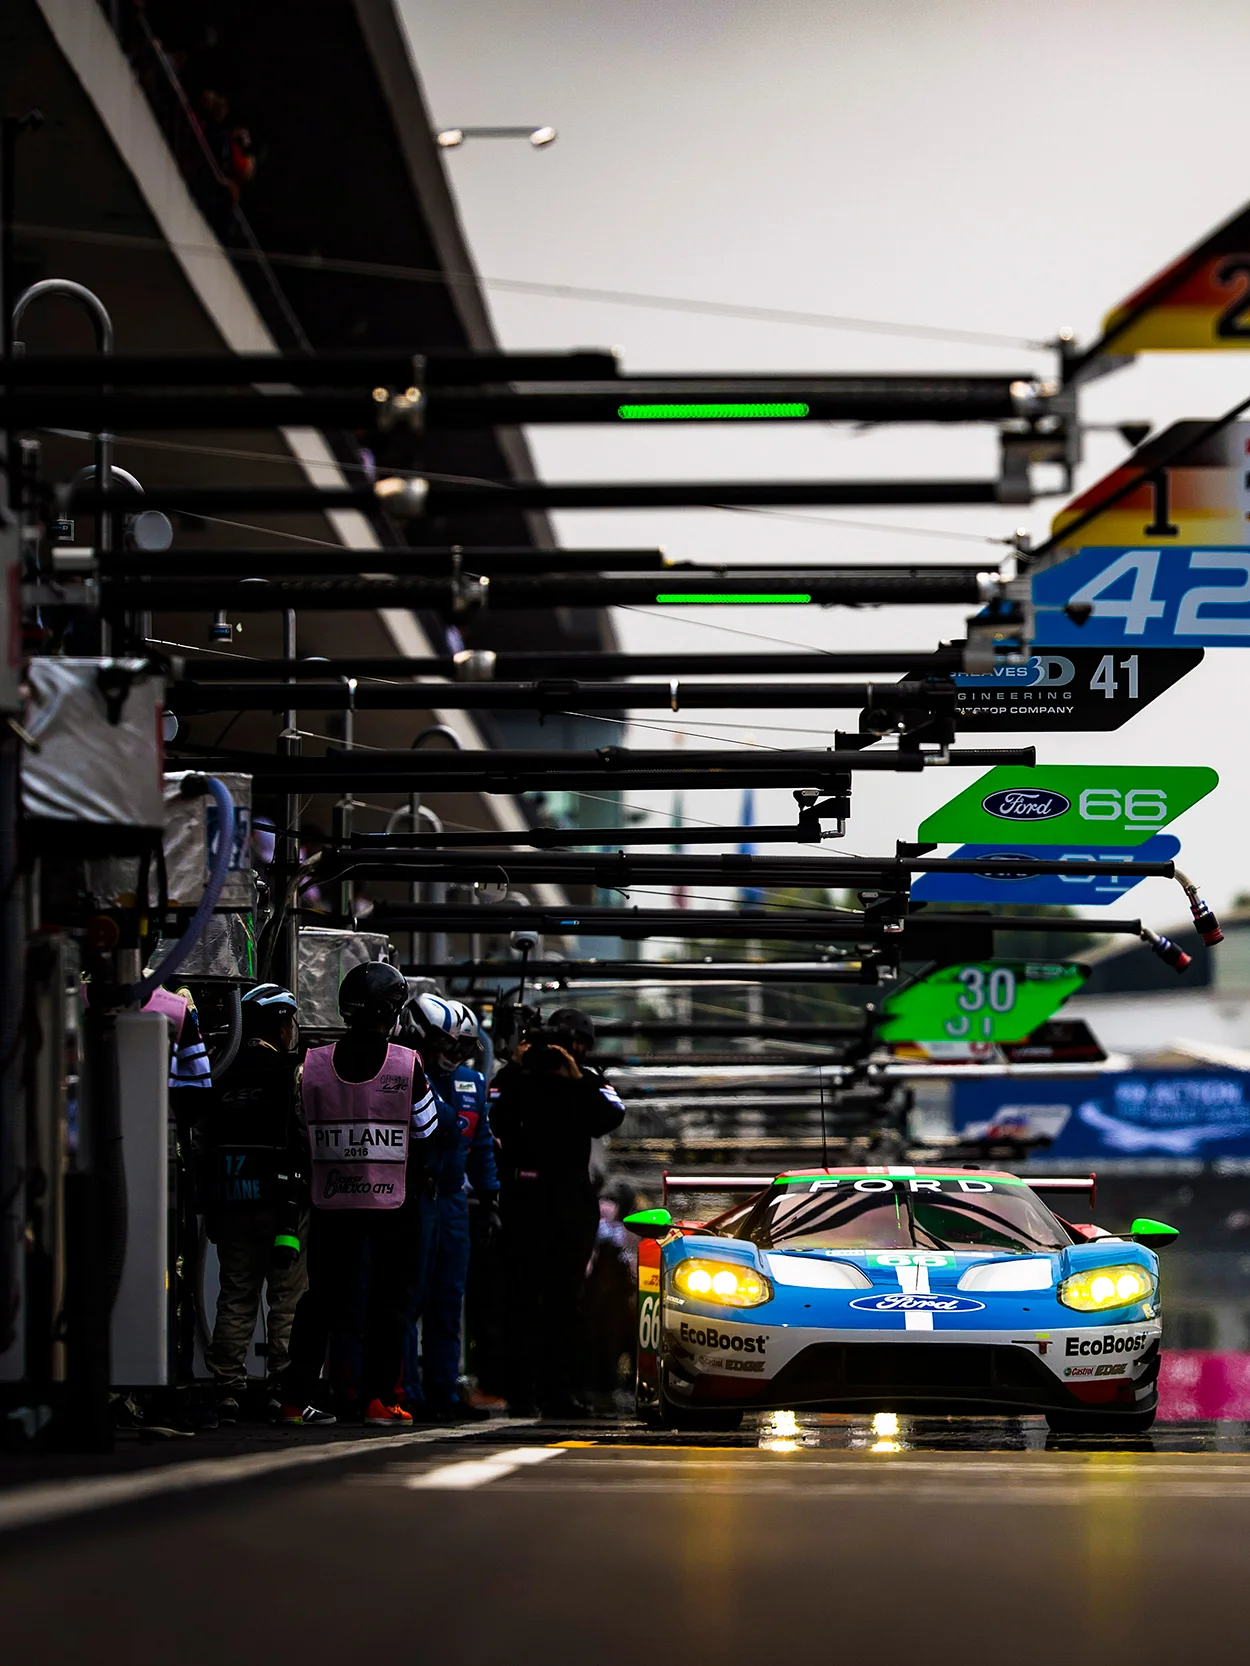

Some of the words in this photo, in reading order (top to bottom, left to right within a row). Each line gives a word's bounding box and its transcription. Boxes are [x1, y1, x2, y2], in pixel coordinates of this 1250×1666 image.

[1144, 468, 1179, 537] 1
[1089, 654, 1140, 700] 41
[957, 691, 1072, 700] GINEERING
[1010, 706, 1074, 714] COMPANY
[999, 792, 1052, 817] Ford
[1079, 788, 1168, 821] 66
[957, 966, 1016, 1013] 30
[314, 1129, 342, 1148] PIT
[349, 1129, 404, 1147] LANE
[344, 1148, 369, 1157] 2016
[336, 1183, 371, 1194] MEXICO
[372, 1183, 395, 1194] CITY
[809, 1178, 994, 1193] FORD
[876, 1253, 948, 1267] 66
[876, 1294, 958, 1313] Ford
[639, 1295, 660, 1350] 66
[680, 1321, 766, 1354] EcoBoost
[1066, 1333, 1146, 1355] EcoBoost
[1072, 1367, 1093, 1376] Castrol
